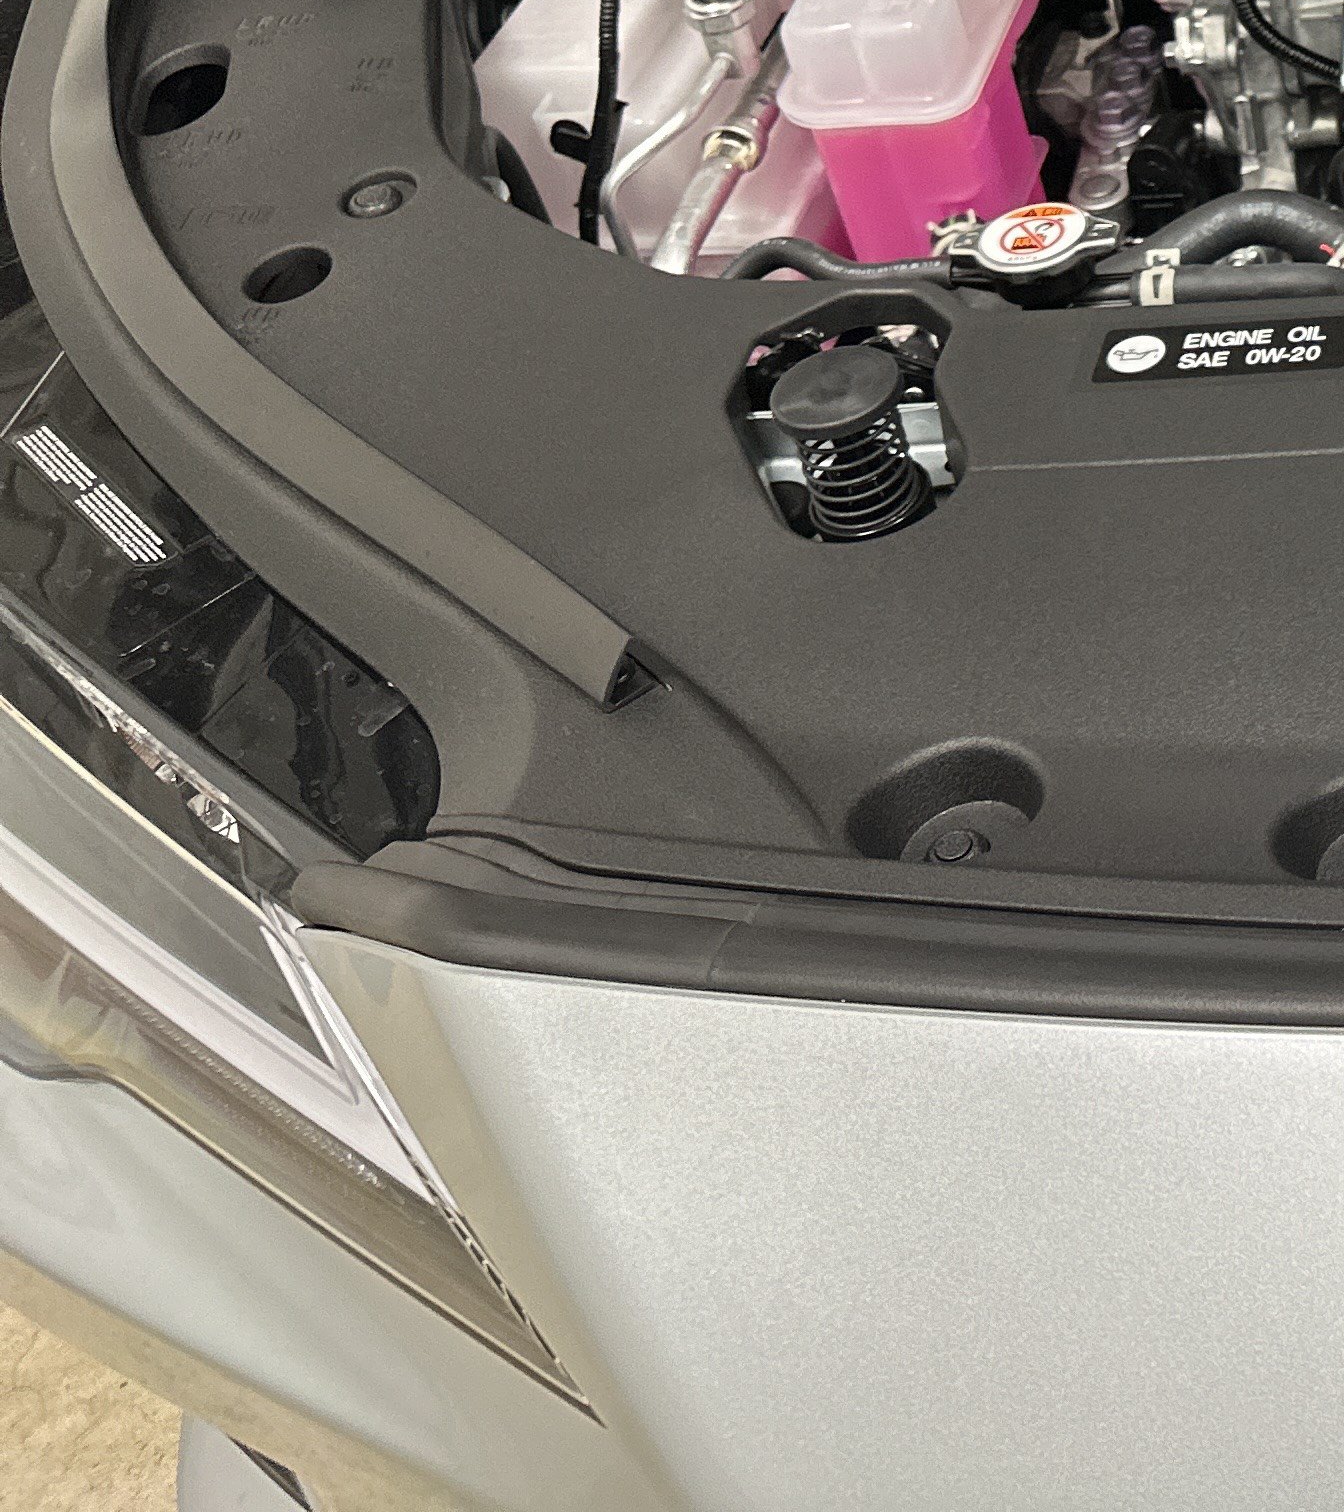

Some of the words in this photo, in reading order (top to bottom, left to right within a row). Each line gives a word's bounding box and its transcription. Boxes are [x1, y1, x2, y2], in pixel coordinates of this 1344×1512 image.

[1182, 328, 1274, 349] ENGINE
[1286, 325, 1327, 342] OIL
[1177, 350, 1230, 369] SAE
[1245, 345, 1321, 365] 0W-20
